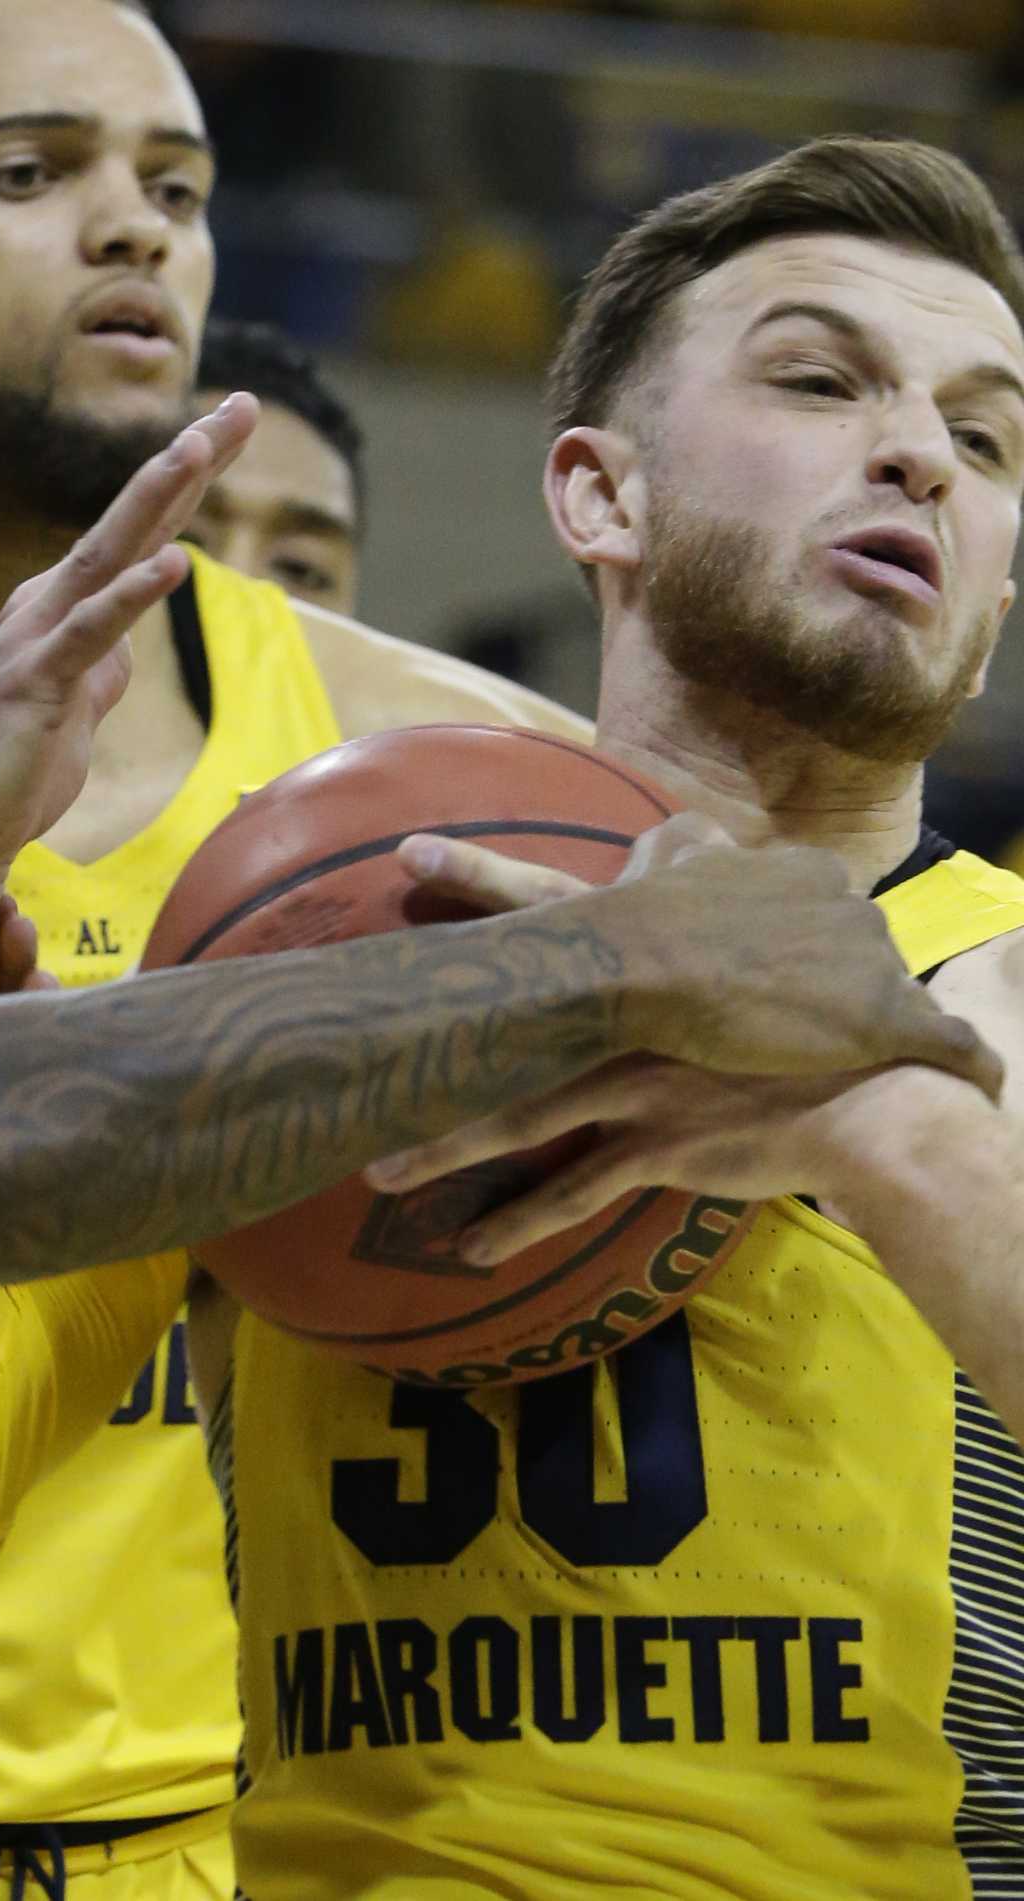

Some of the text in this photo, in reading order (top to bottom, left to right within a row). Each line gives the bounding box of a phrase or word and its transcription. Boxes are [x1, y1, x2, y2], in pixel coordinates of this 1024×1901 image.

[74, 918, 120, 955] AL
[331, 1308, 709, 1567] 30
[274, 1615, 871, 1761] MARQUETTE
